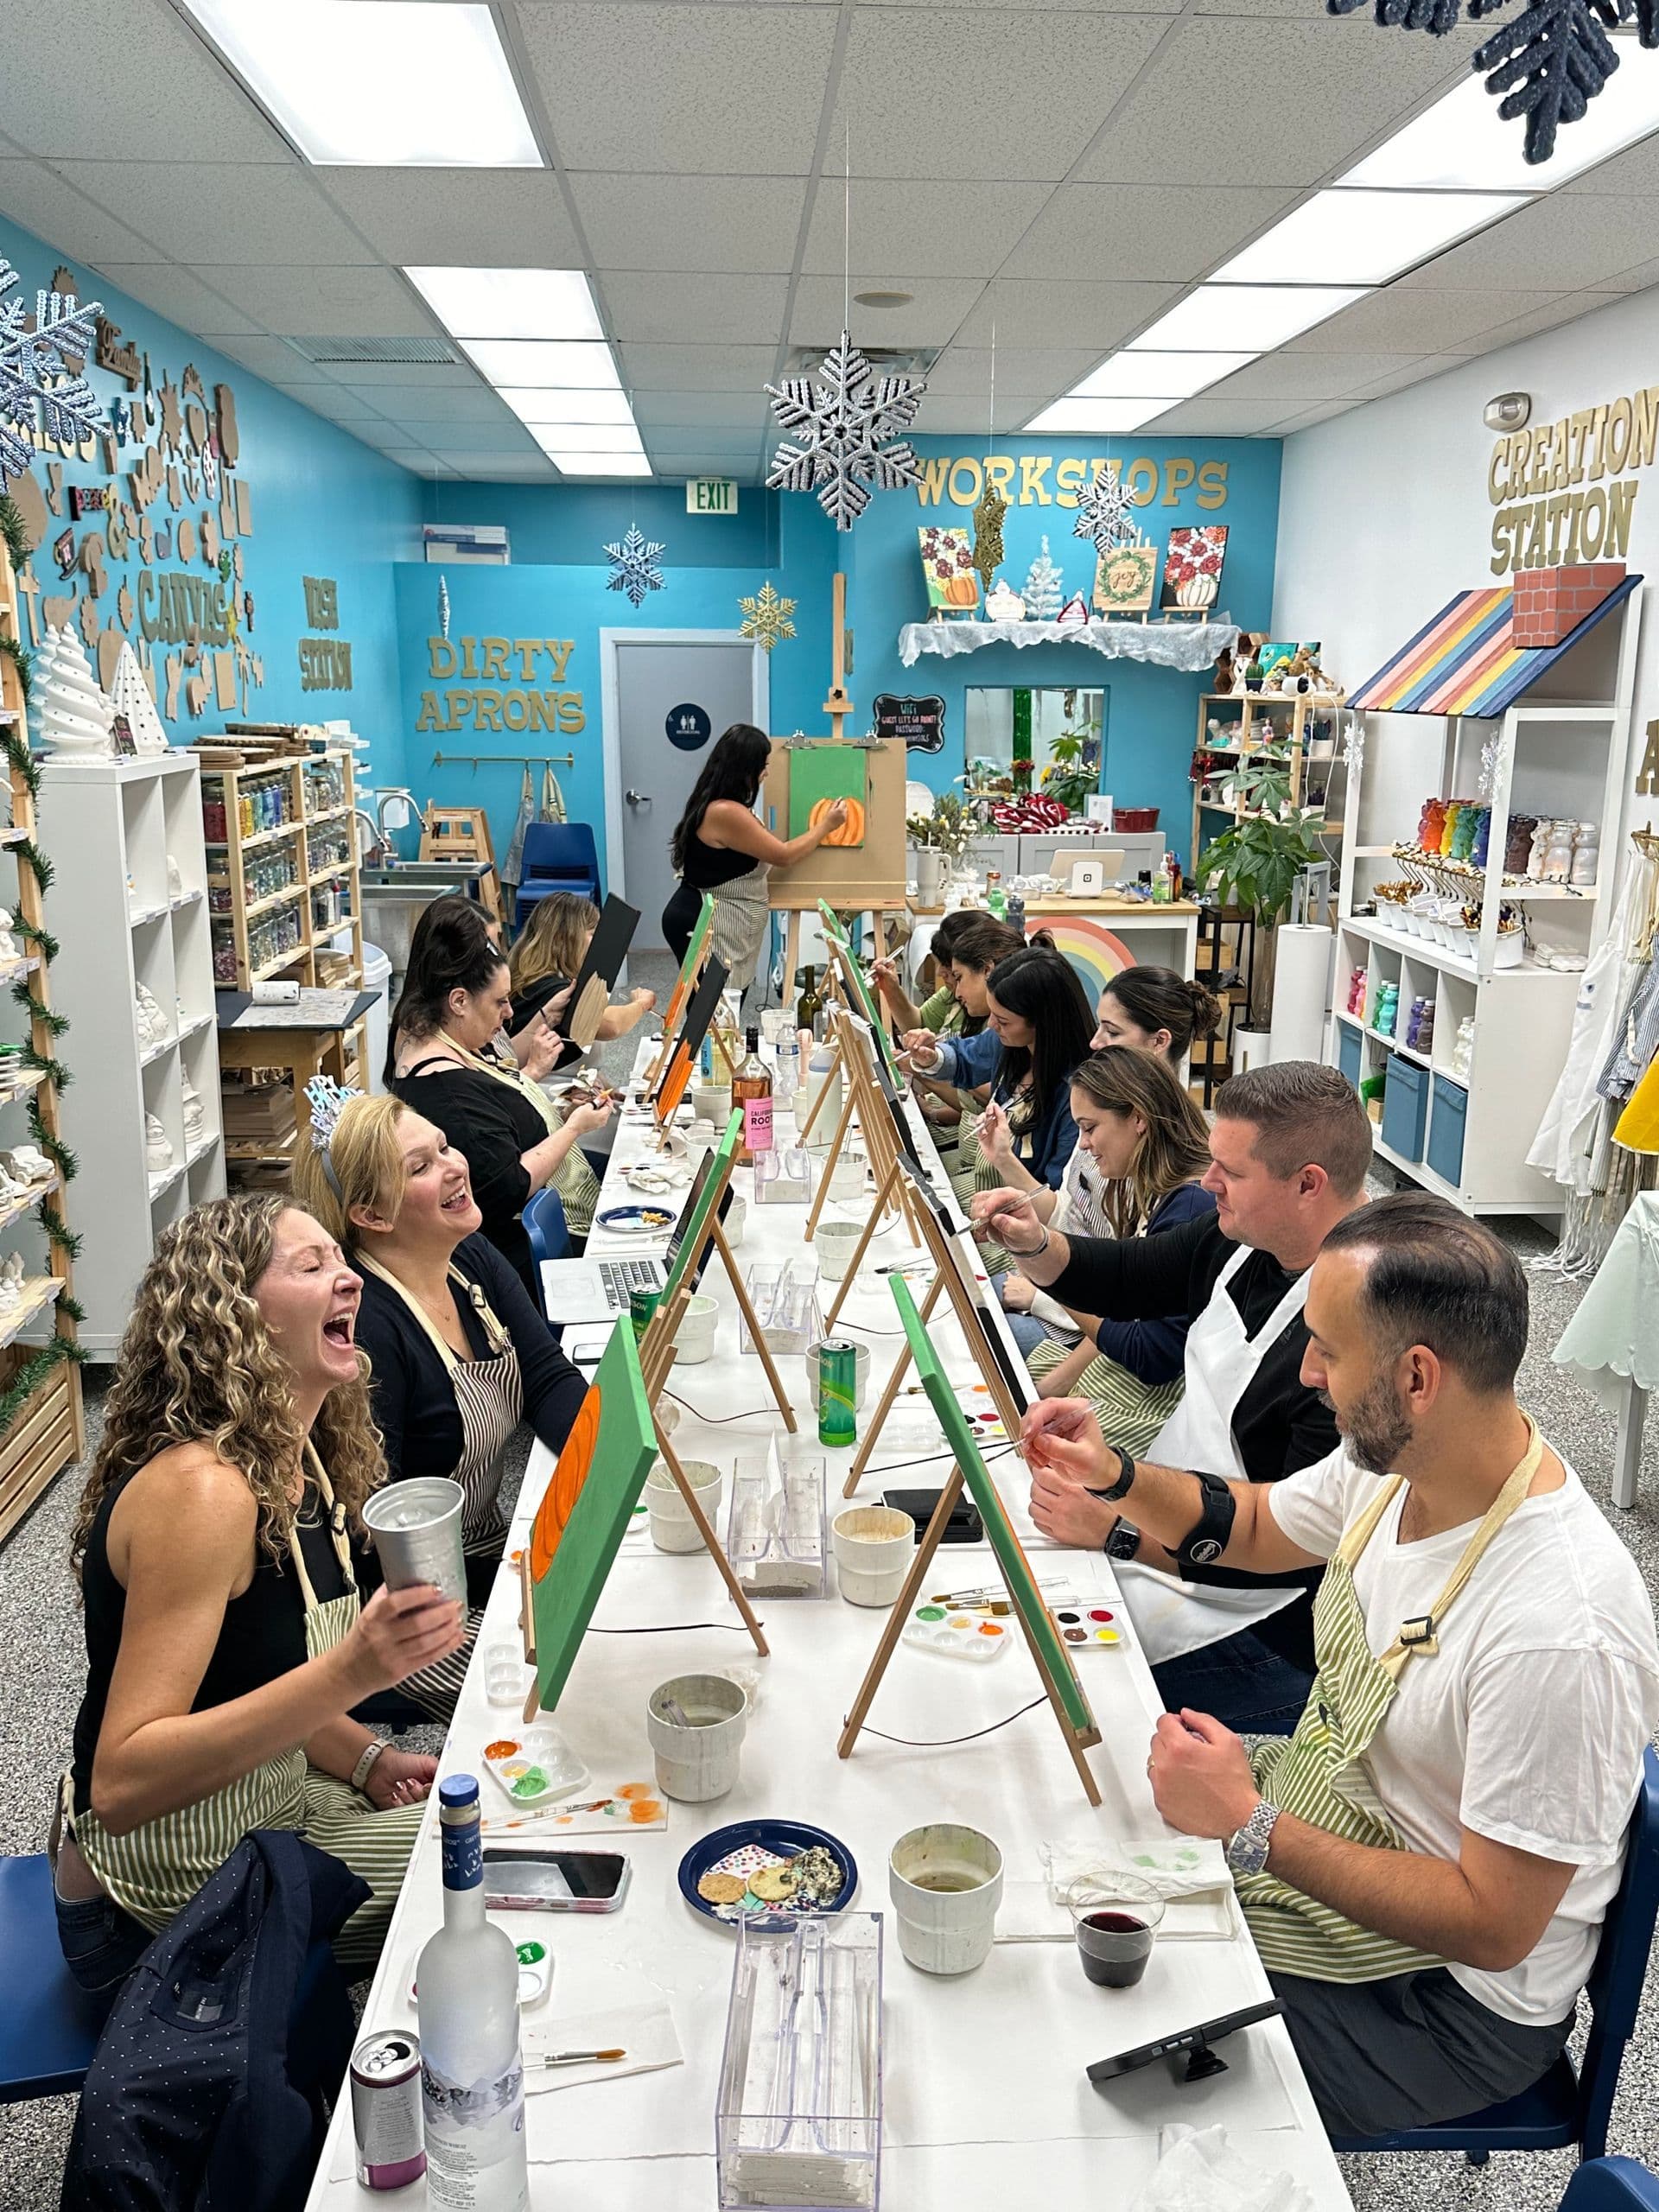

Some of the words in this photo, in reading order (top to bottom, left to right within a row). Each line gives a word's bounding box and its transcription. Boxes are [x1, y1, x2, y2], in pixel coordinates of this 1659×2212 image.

[1488, 385, 1659, 505] CREATION
[696, 482, 731, 510] EXIT
[1490, 480, 1639, 576] STATION
[138, 569, 230, 649] CANVAS
[302, 575, 340, 631] WASH
[298, 637, 353, 692] STATION
[428, 636, 575, 682] DIRTY
[416, 689, 587, 734] APRONS
